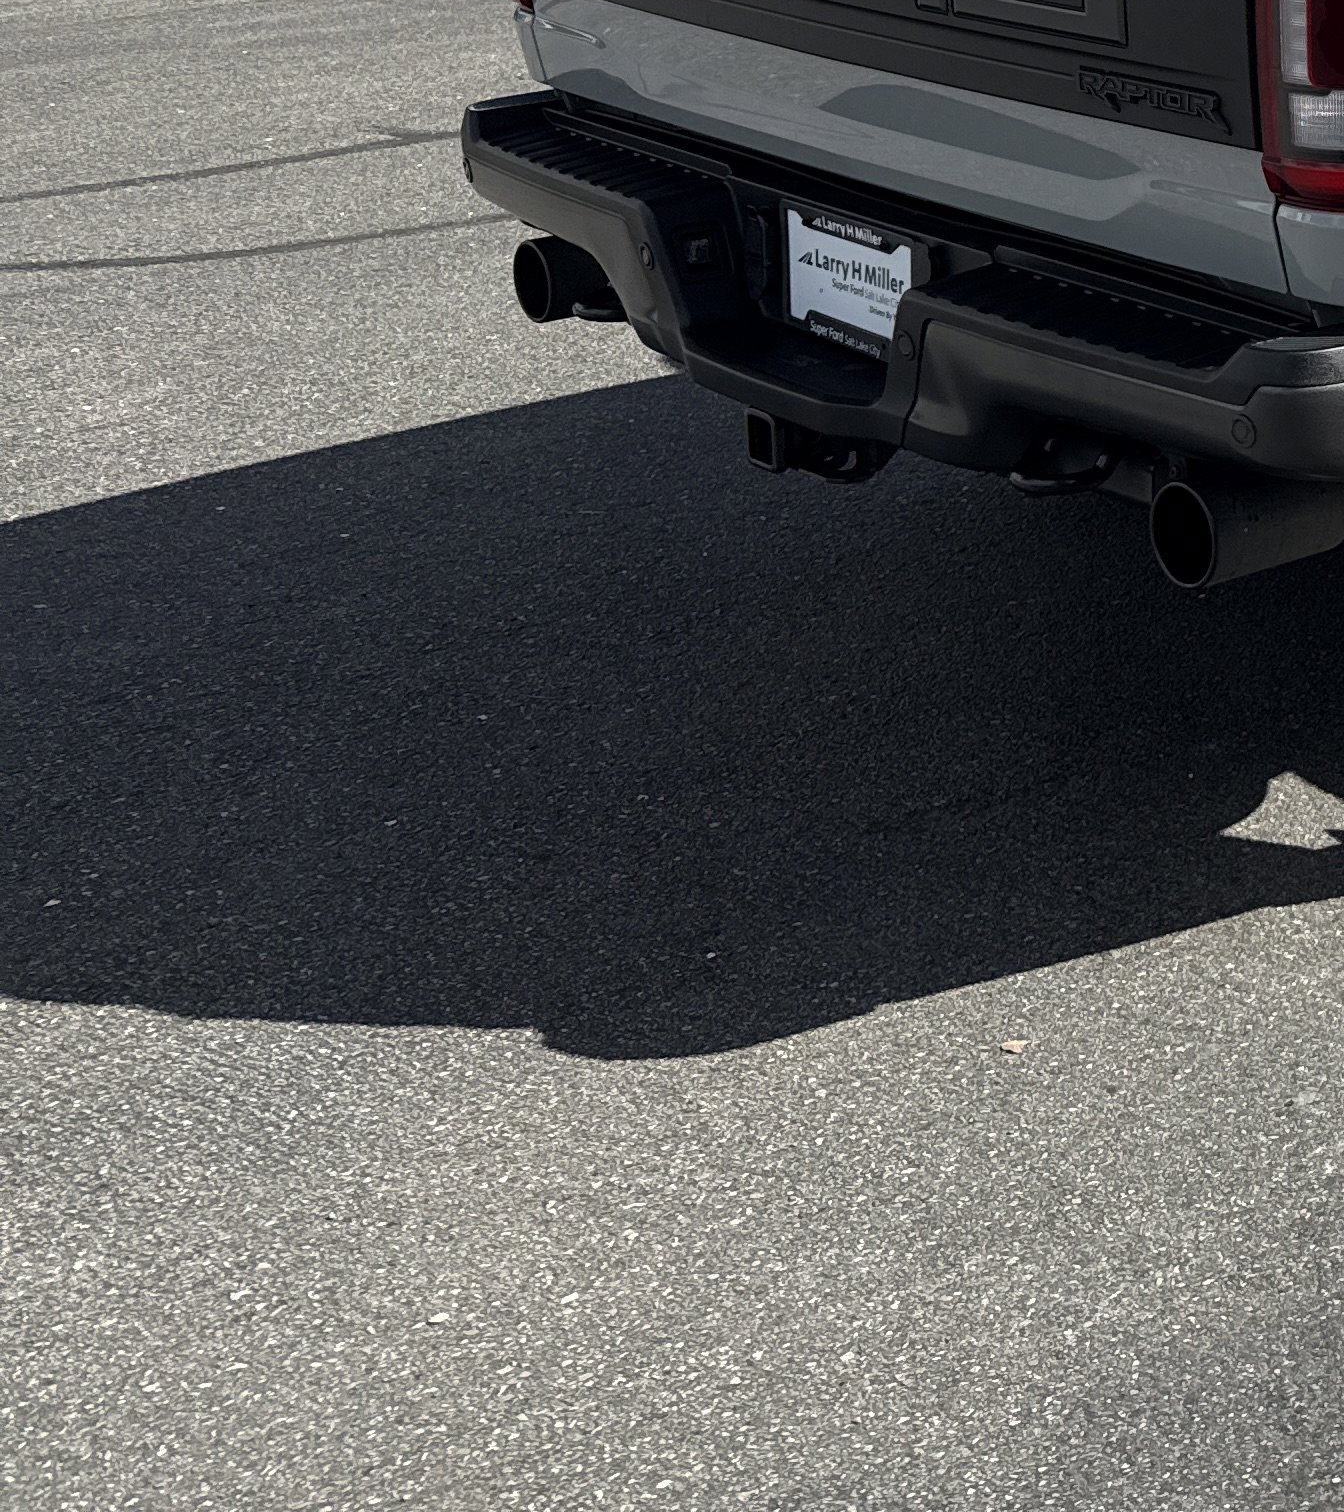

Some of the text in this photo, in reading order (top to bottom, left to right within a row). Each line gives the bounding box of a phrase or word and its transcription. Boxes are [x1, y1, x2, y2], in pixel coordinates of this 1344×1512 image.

[1079, 68, 1232, 135] RAPTOR
[821, 216, 883, 246] Larry H Miller
[815, 248, 904, 295] Larry H Miller
[831, 277, 849, 292] Super
[849, 283, 864, 297] Ford
[809, 319, 829, 337] Super
[828, 326, 844, 343] Ford
